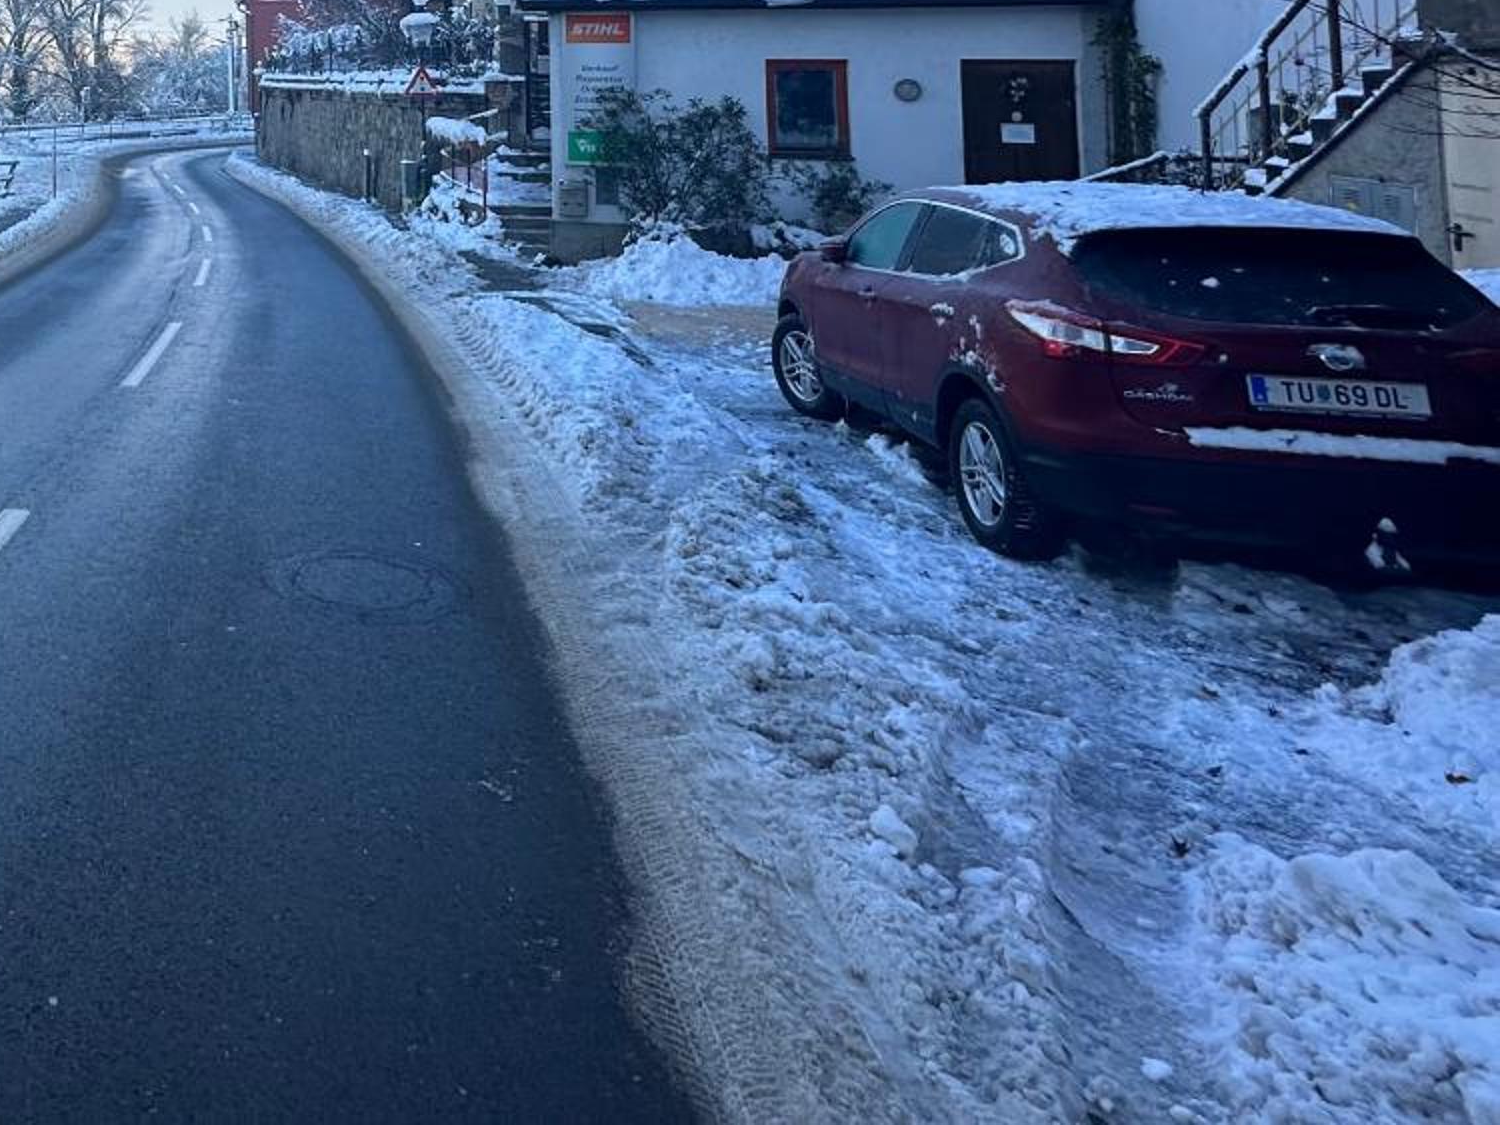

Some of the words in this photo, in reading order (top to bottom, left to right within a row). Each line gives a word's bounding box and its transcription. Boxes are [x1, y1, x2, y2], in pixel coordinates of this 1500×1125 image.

[571, 22, 625, 36] STIHL
[1280, 381, 1315, 403] TU
[1334, 384, 1368, 406] 69
[1375, 386, 1408, 410] DL
